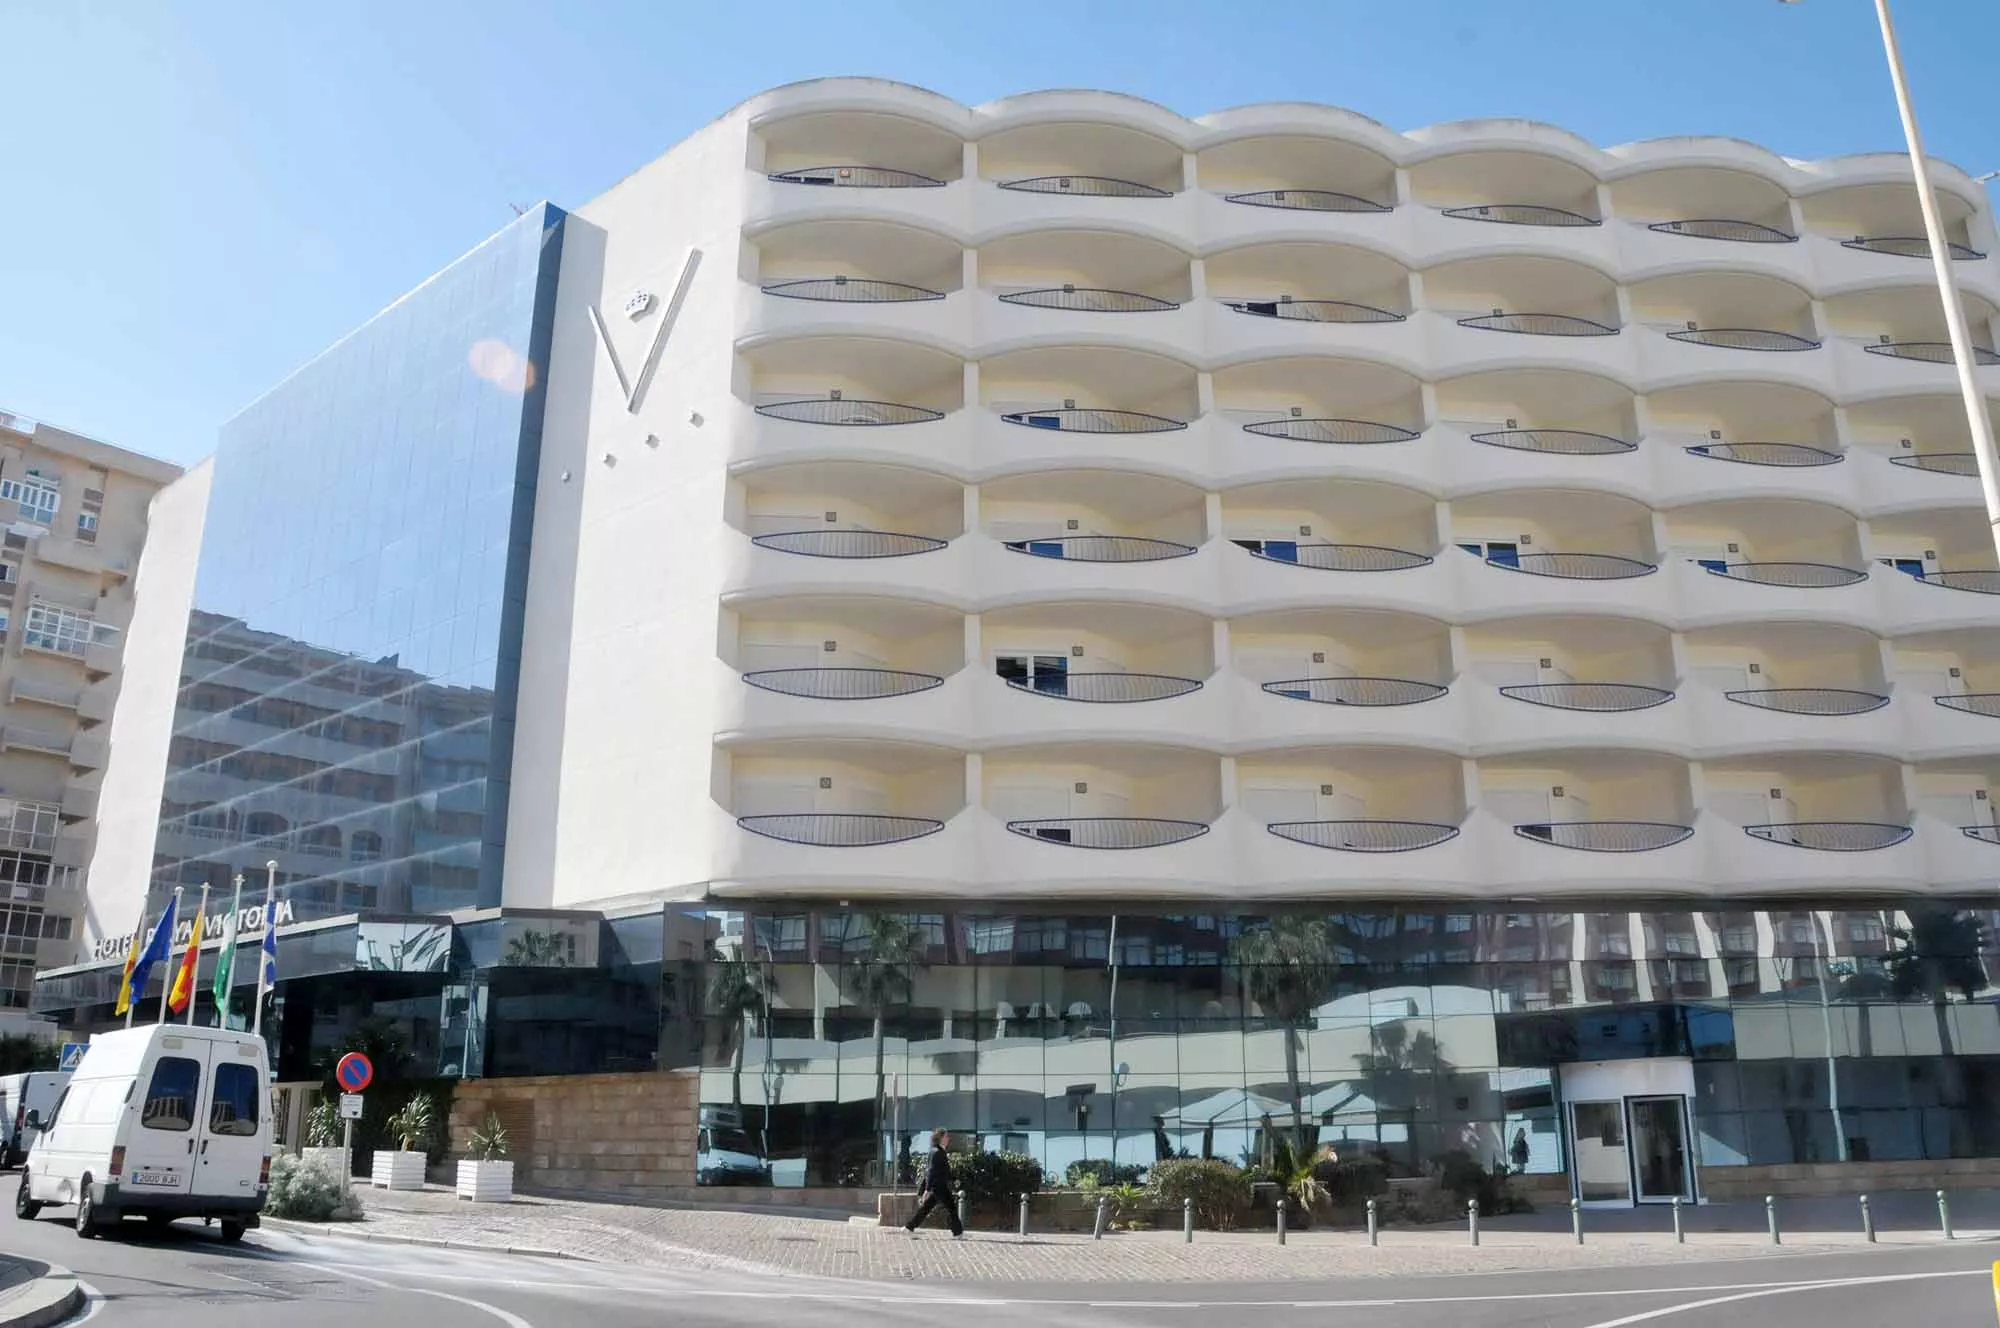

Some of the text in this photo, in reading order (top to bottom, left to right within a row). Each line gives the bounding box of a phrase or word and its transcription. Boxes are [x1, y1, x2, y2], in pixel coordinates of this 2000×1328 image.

[95, 899, 294, 959] HOTE PYA VITOIA
